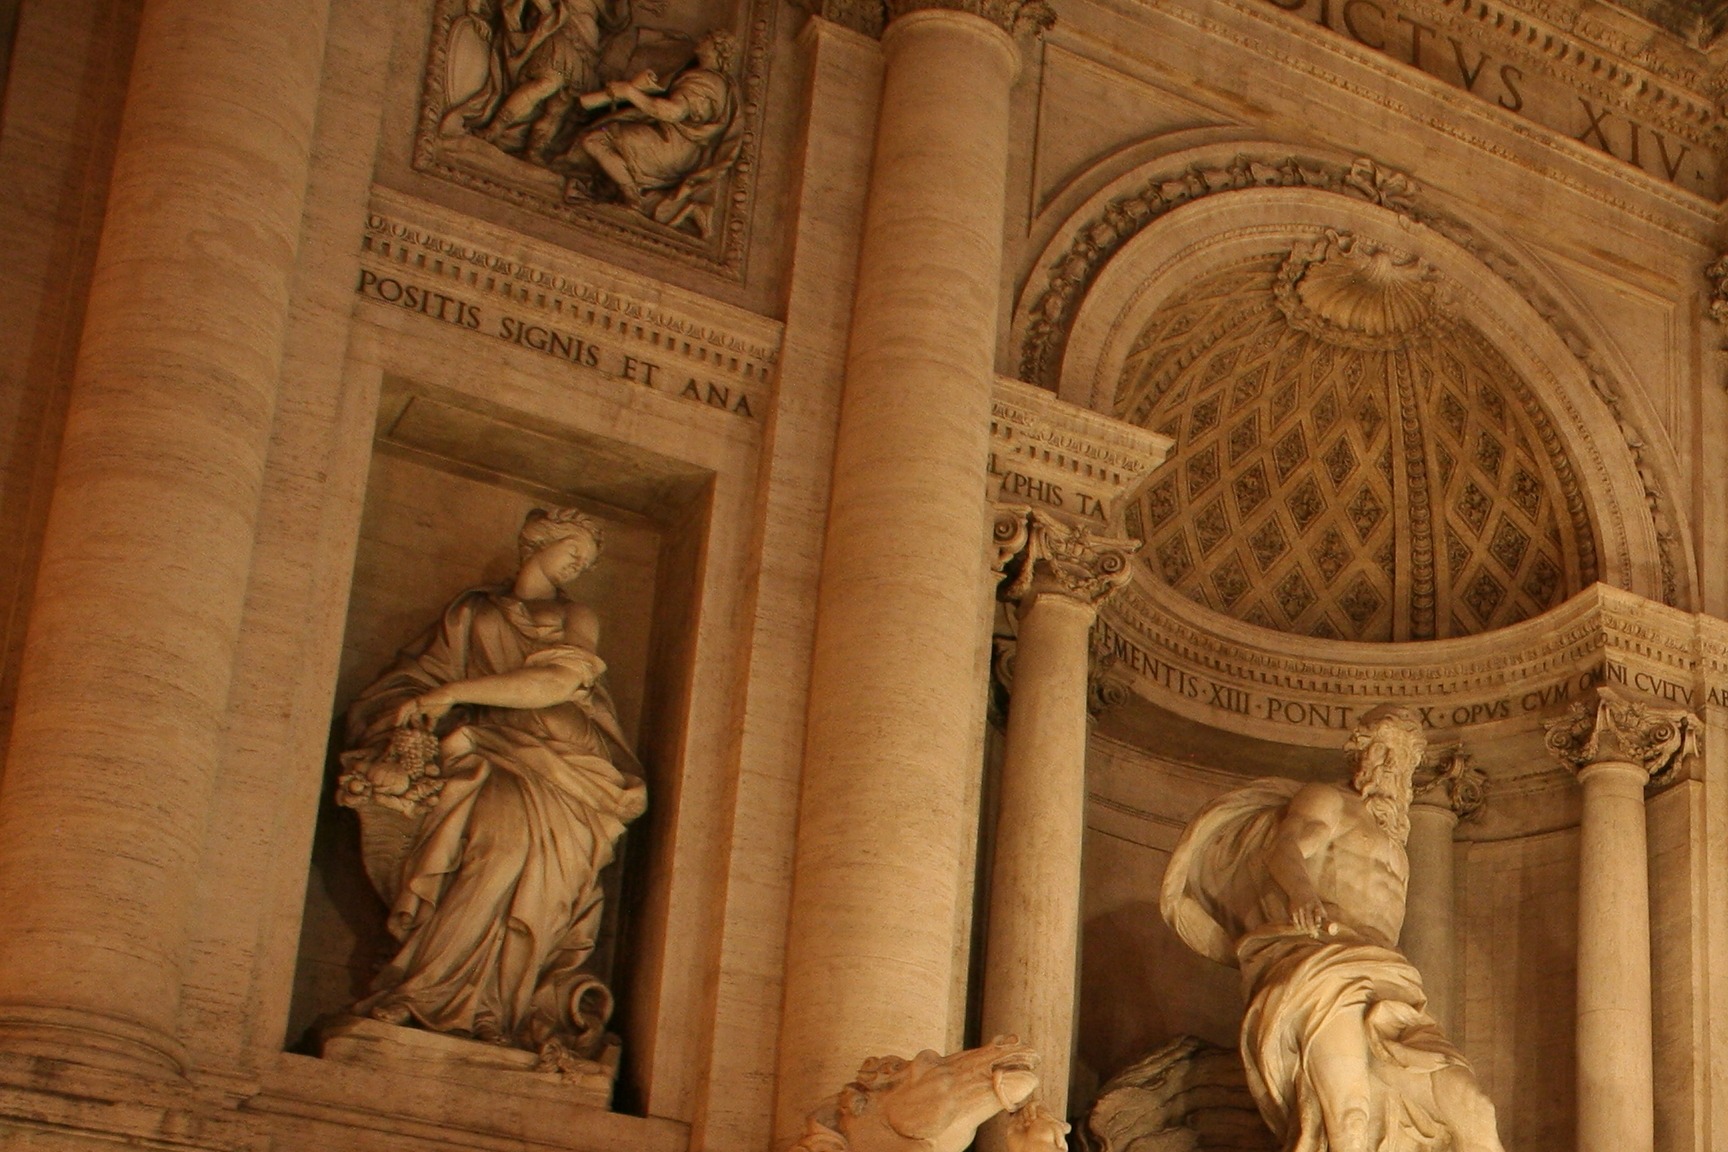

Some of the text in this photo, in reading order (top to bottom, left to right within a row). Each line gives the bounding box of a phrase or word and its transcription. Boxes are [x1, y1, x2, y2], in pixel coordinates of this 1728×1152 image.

[1264, 0, 1523, 112] ICTVS
[355, 269, 754, 418] POSITIS SIGNIS ET ANA
[1075, 493, 1108, 522] TA
[1452, 700, 1511, 725] OPVS
[1521, 681, 1570, 711] CVM
[1634, 672, 1695, 705] CVLTV
